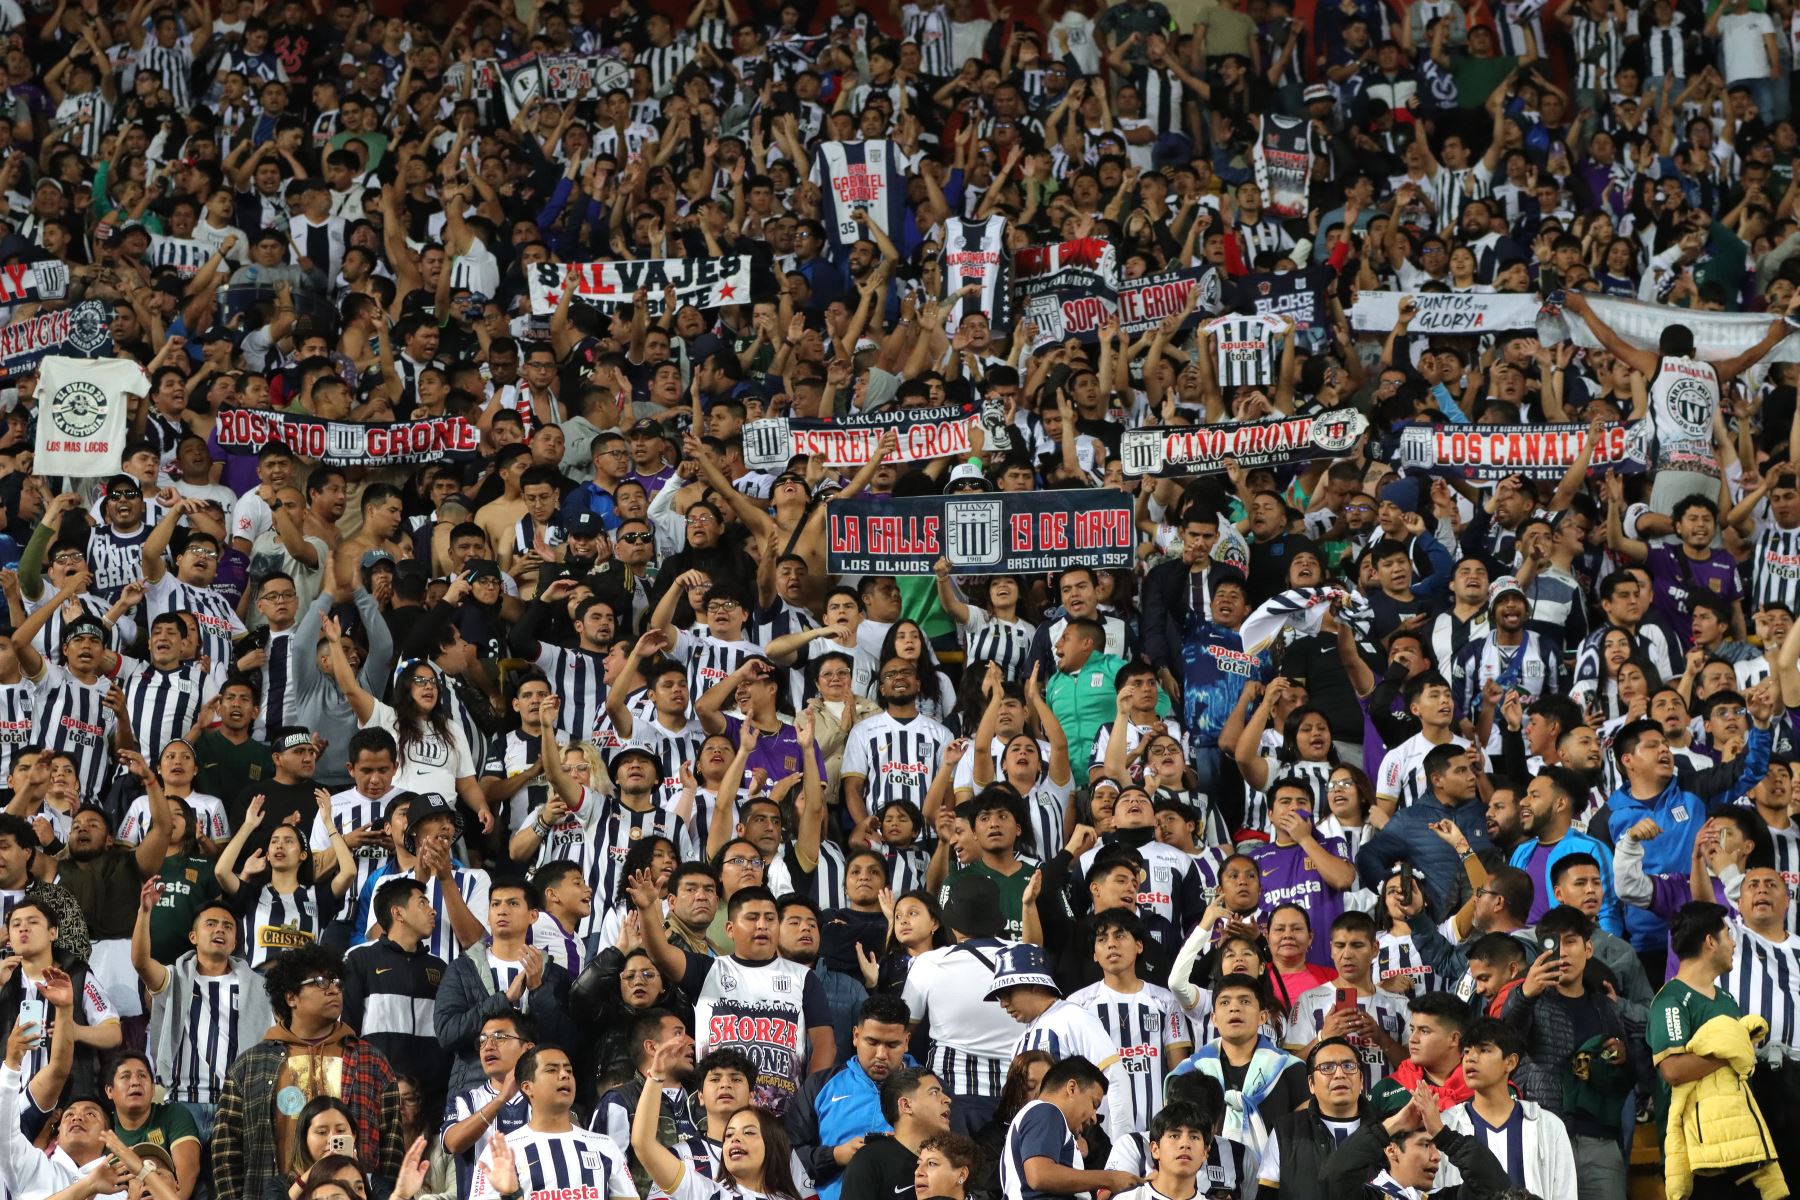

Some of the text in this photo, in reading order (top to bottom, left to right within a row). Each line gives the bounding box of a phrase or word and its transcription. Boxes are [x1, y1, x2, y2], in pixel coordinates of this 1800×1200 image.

[832, 174, 884, 191] GABRIEL
[839, 187, 879, 203] GRONE
[840, 221, 856, 235] 35
[536, 256, 741, 295] SALVAJES
[960, 266, 985, 277] GRONE
[1254, 290, 1315, 313] BLOKE
[1414, 295, 1474, 311] JUNTOS
[1420, 312, 1484, 329] GLORYA
[1220, 341, 1265, 351] apuesta
[1232, 351, 1257, 361] total
[9, 360, 37, 375] ESPAÑA
[55, 386, 68, 401] EL
[66, 381, 96, 395] OVALO
[1669, 381, 1694, 411] ENRIKE
[836, 406, 960, 426] CERCADO GRONE
[54, 416, 104, 437] LA VICTORIA
[217, 409, 477, 459] ROSARIO GRONE
[1493, 425, 1499, 433] Y
[1500, 424, 1532, 433] SIEMPRE
[1533, 424, 1544, 432] LA
[1545, 423, 1580, 432] HISTORIA
[46, 441, 109, 454] LOS MAS LOCOS
[1166, 427, 1226, 465] CAÑO
[1233, 418, 1314, 458] GRONE
[1435, 432, 1483, 466] LOS
[419, 451, 444, 463] LADO
[1271, 452, 1290, 462] #10
[953, 503, 995, 511] ALIANZA
[830, 509, 1131, 555] LA CALLE 19 DE MAYO
[991, 519, 999, 543] LIMA
[841, 553, 1129, 572] LOS OLIVOS BASTIÓN DESDE 1997
[1208, 645, 1261, 667] apuesta
[1217, 657, 1251, 677] total
[60, 716, 105, 737] apuesta
[0, 731, 27, 742] total
[69, 730, 95, 748] total
[881, 760, 929, 774] apuesta
[889, 773, 919, 786] total
[1137, 892, 1169, 904] esta
[1263, 879, 1321, 906] apuesta
[1381, 965, 1432, 979] apuesta
[994, 976, 1016, 989] LIMA
[84, 984, 103, 1013] TORITO
[87, 981, 107, 1010] LOTERIAS
[1665, 1007, 1675, 1041] LOTERIAS
[1672, 1006, 1683, 1041] TORITO
[710, 1016, 798, 1049] SKORZA
[1118, 1043, 1158, 1057] uesta
[1362, 1050, 1383, 1064] tal
[1126, 1055, 1149, 1072] tal
[530, 1185, 599, 1200] apuesta
